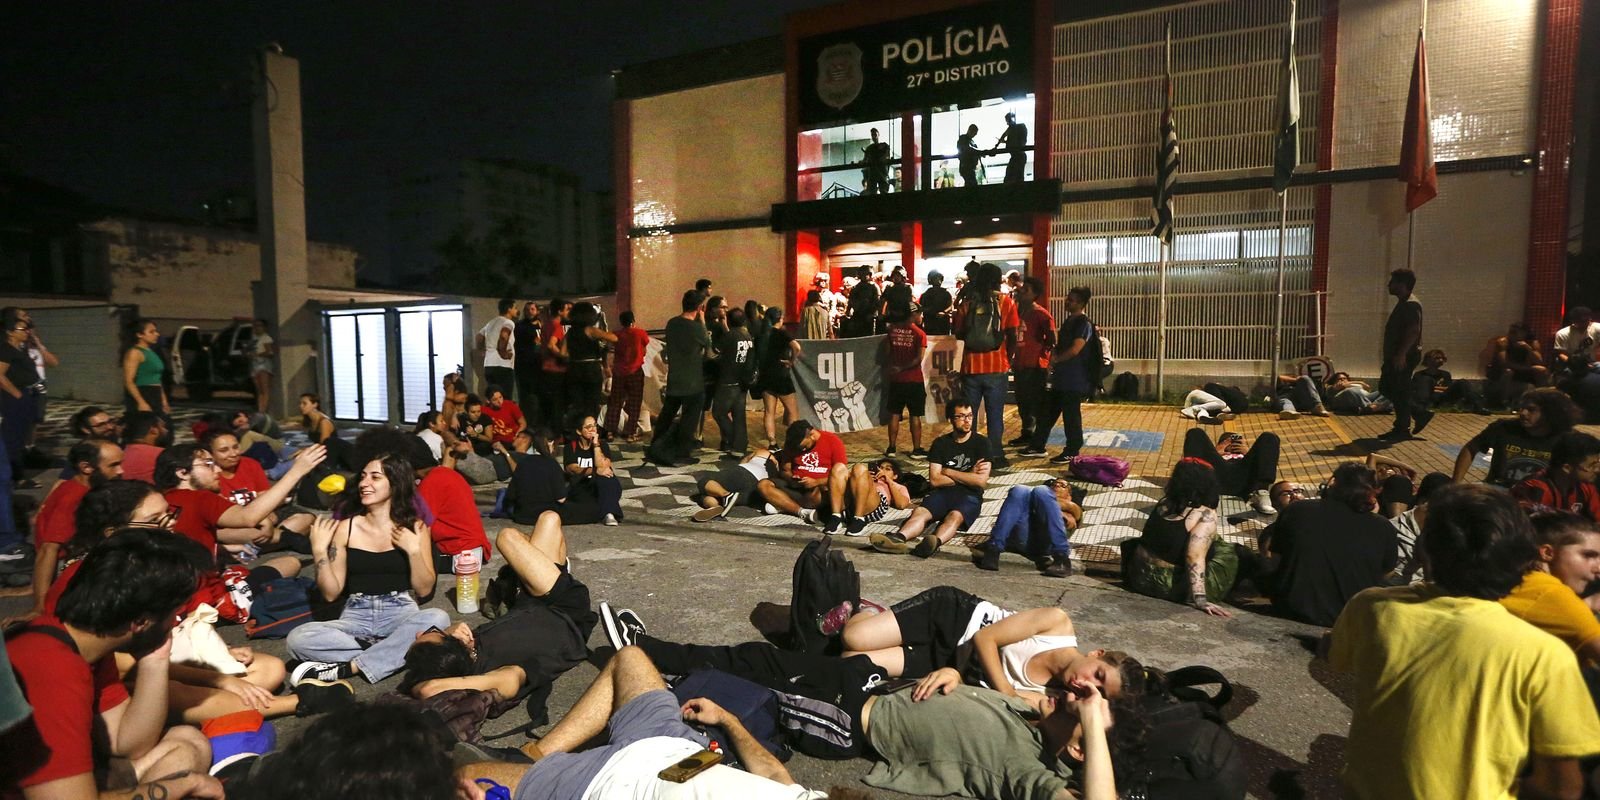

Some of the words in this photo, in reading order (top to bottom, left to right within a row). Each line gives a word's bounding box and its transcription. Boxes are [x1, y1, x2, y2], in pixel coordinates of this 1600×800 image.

[882, 24, 1009, 69] POLÍCIA
[934, 60, 1010, 84] DISTRITO
[1307, 363, 1323, 379] E
[1505, 444, 1521, 453] LED
